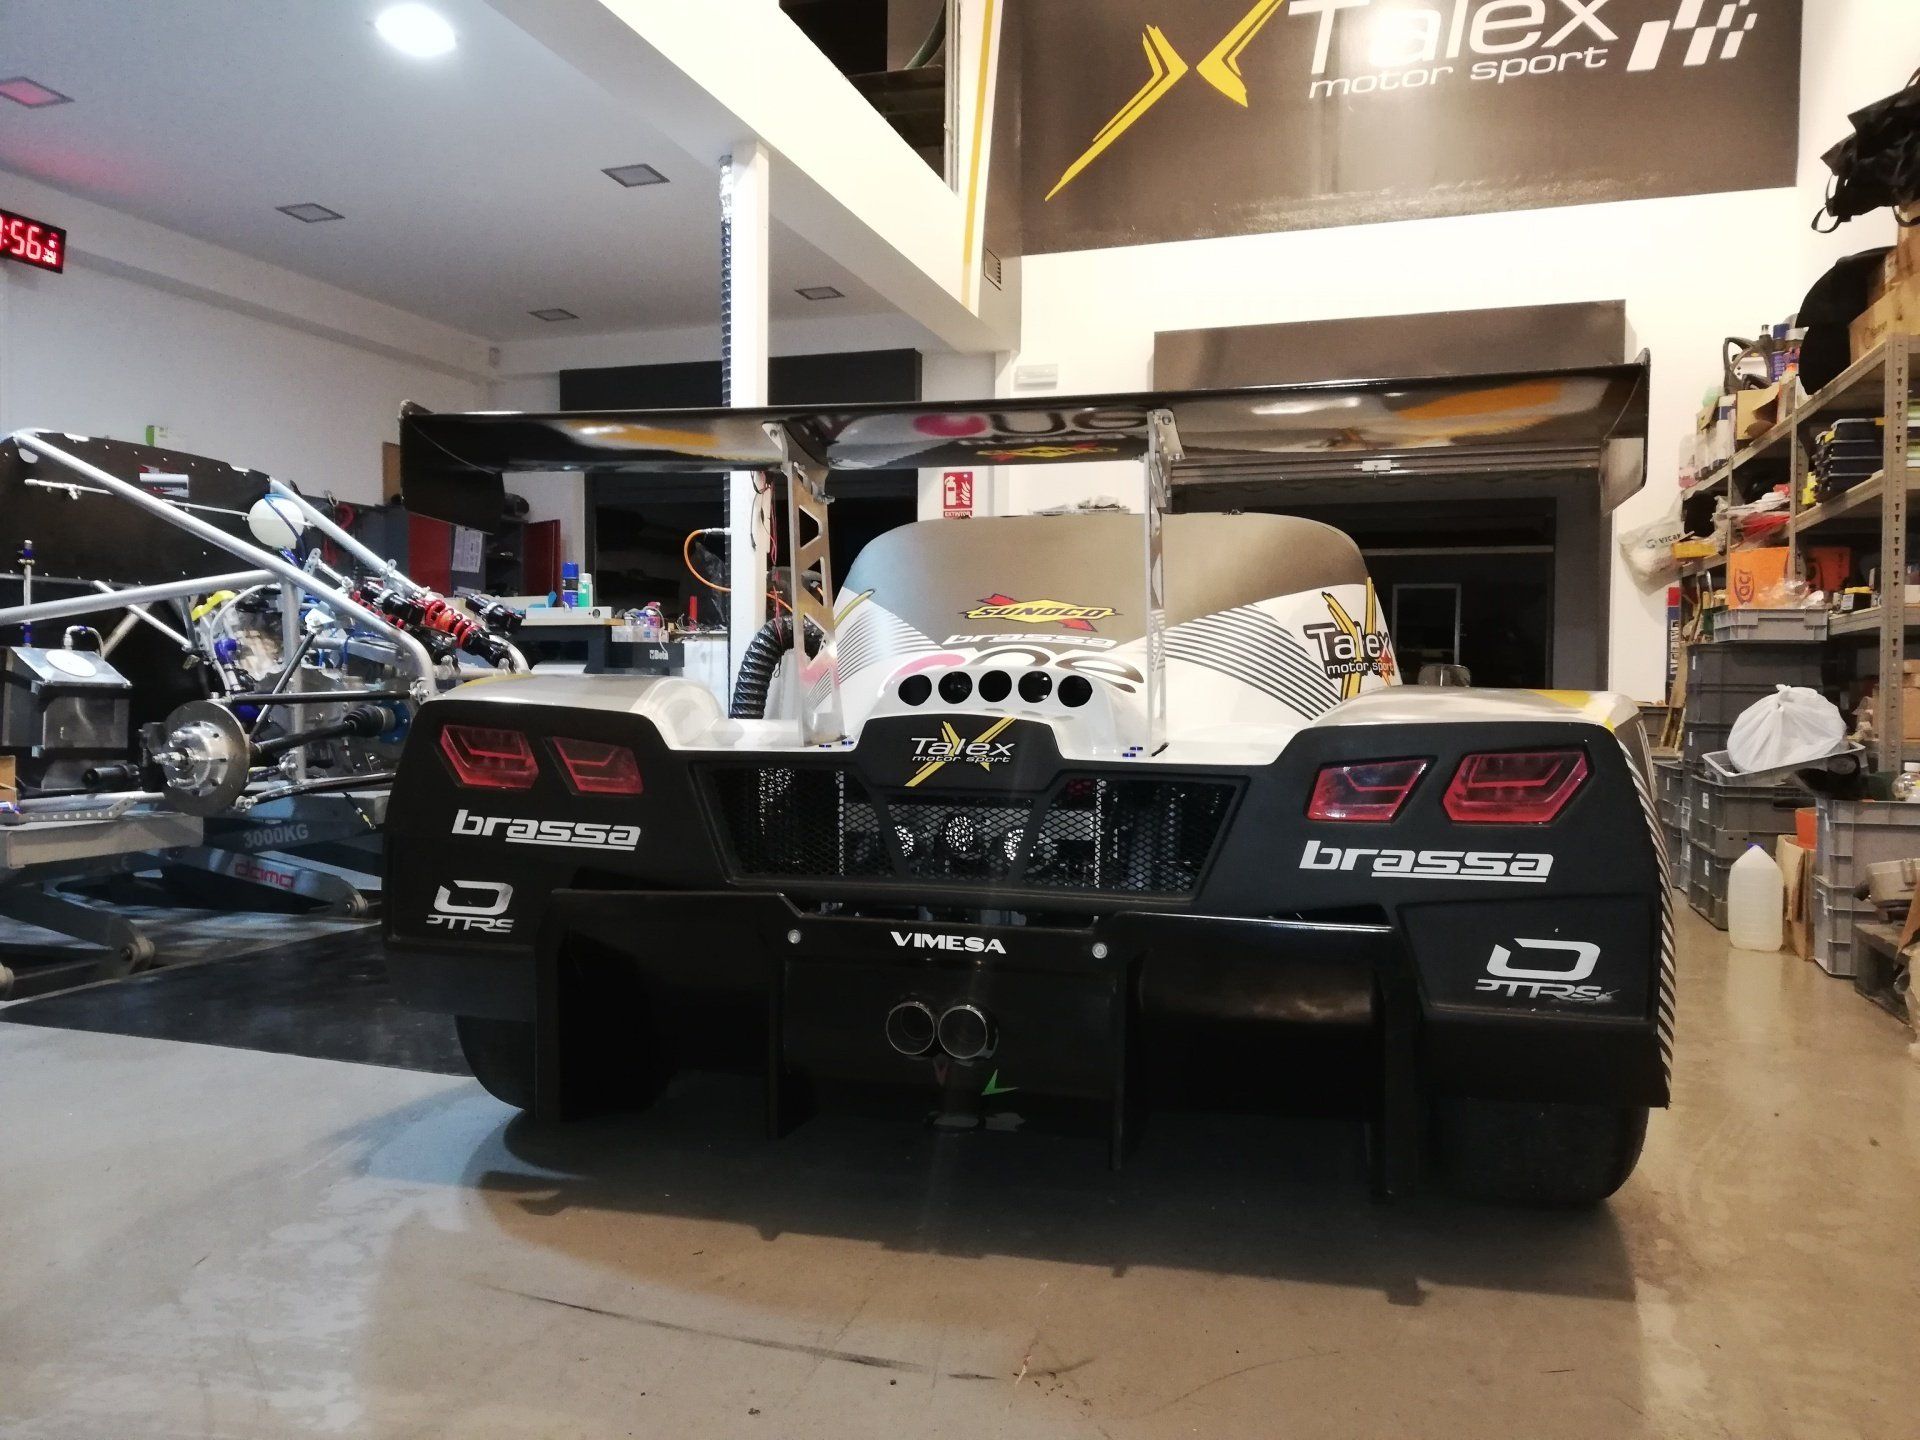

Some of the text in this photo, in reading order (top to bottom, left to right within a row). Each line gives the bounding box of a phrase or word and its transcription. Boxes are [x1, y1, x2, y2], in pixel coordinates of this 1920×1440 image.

[1288, 0, 1618, 75] Talex
[1309, 46, 1608, 98] motor sport
[978, 606, 1107, 618] SUNOCO
[941, 633, 1118, 649] brassa
[1305, 623, 1393, 661] Talex
[1326, 660, 1394, 675] motor sport
[911, 737, 1016, 756] Talex
[965, 755, 1011, 764] sport
[451, 809, 642, 849] brassa
[1299, 840, 1554, 881] brassa
[890, 931, 1007, 955] VIMESA
